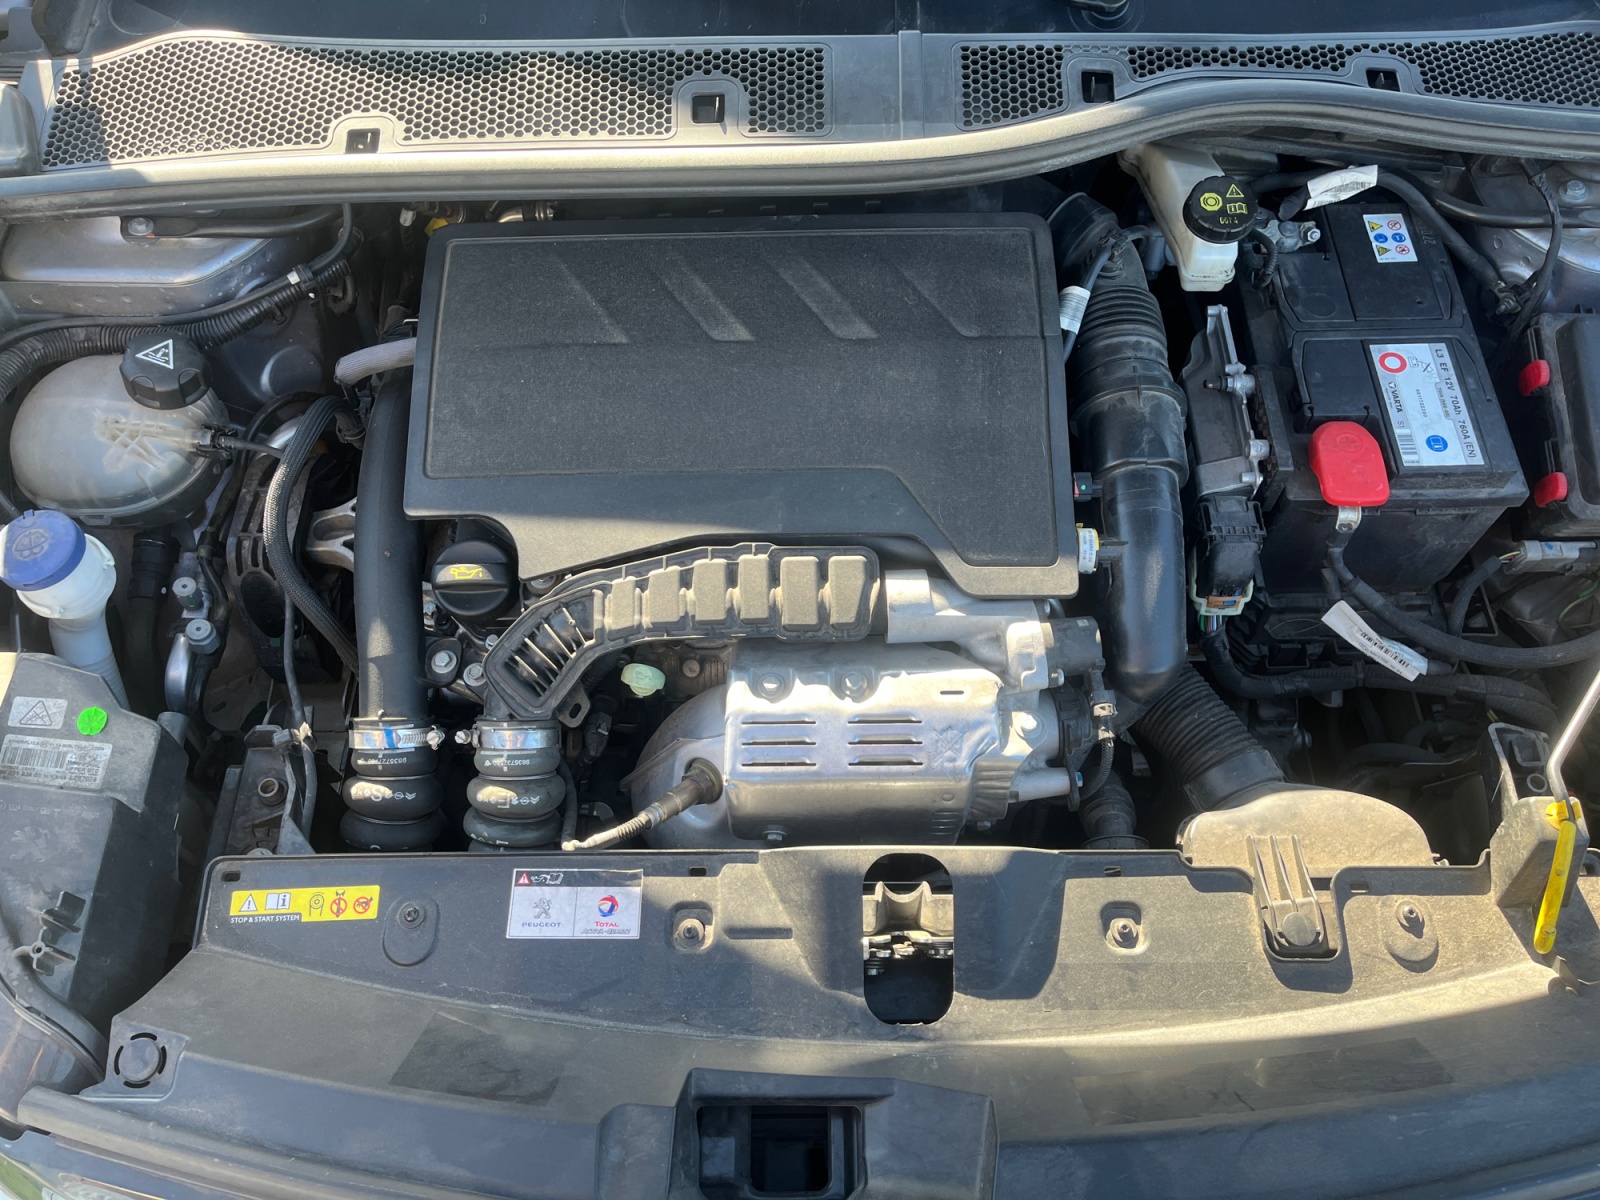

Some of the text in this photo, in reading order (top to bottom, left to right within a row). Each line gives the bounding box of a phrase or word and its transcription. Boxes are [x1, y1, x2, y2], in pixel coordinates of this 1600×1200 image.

[1391, 389, 1403, 413] VARTA
[1435, 349, 1477, 458] L3 EF 12V 70Ah 760A (EN)
[254, 915, 274, 923] START
[275, 914, 300, 922] SYSTEM
[594, 920, 620, 928] TOTAL
